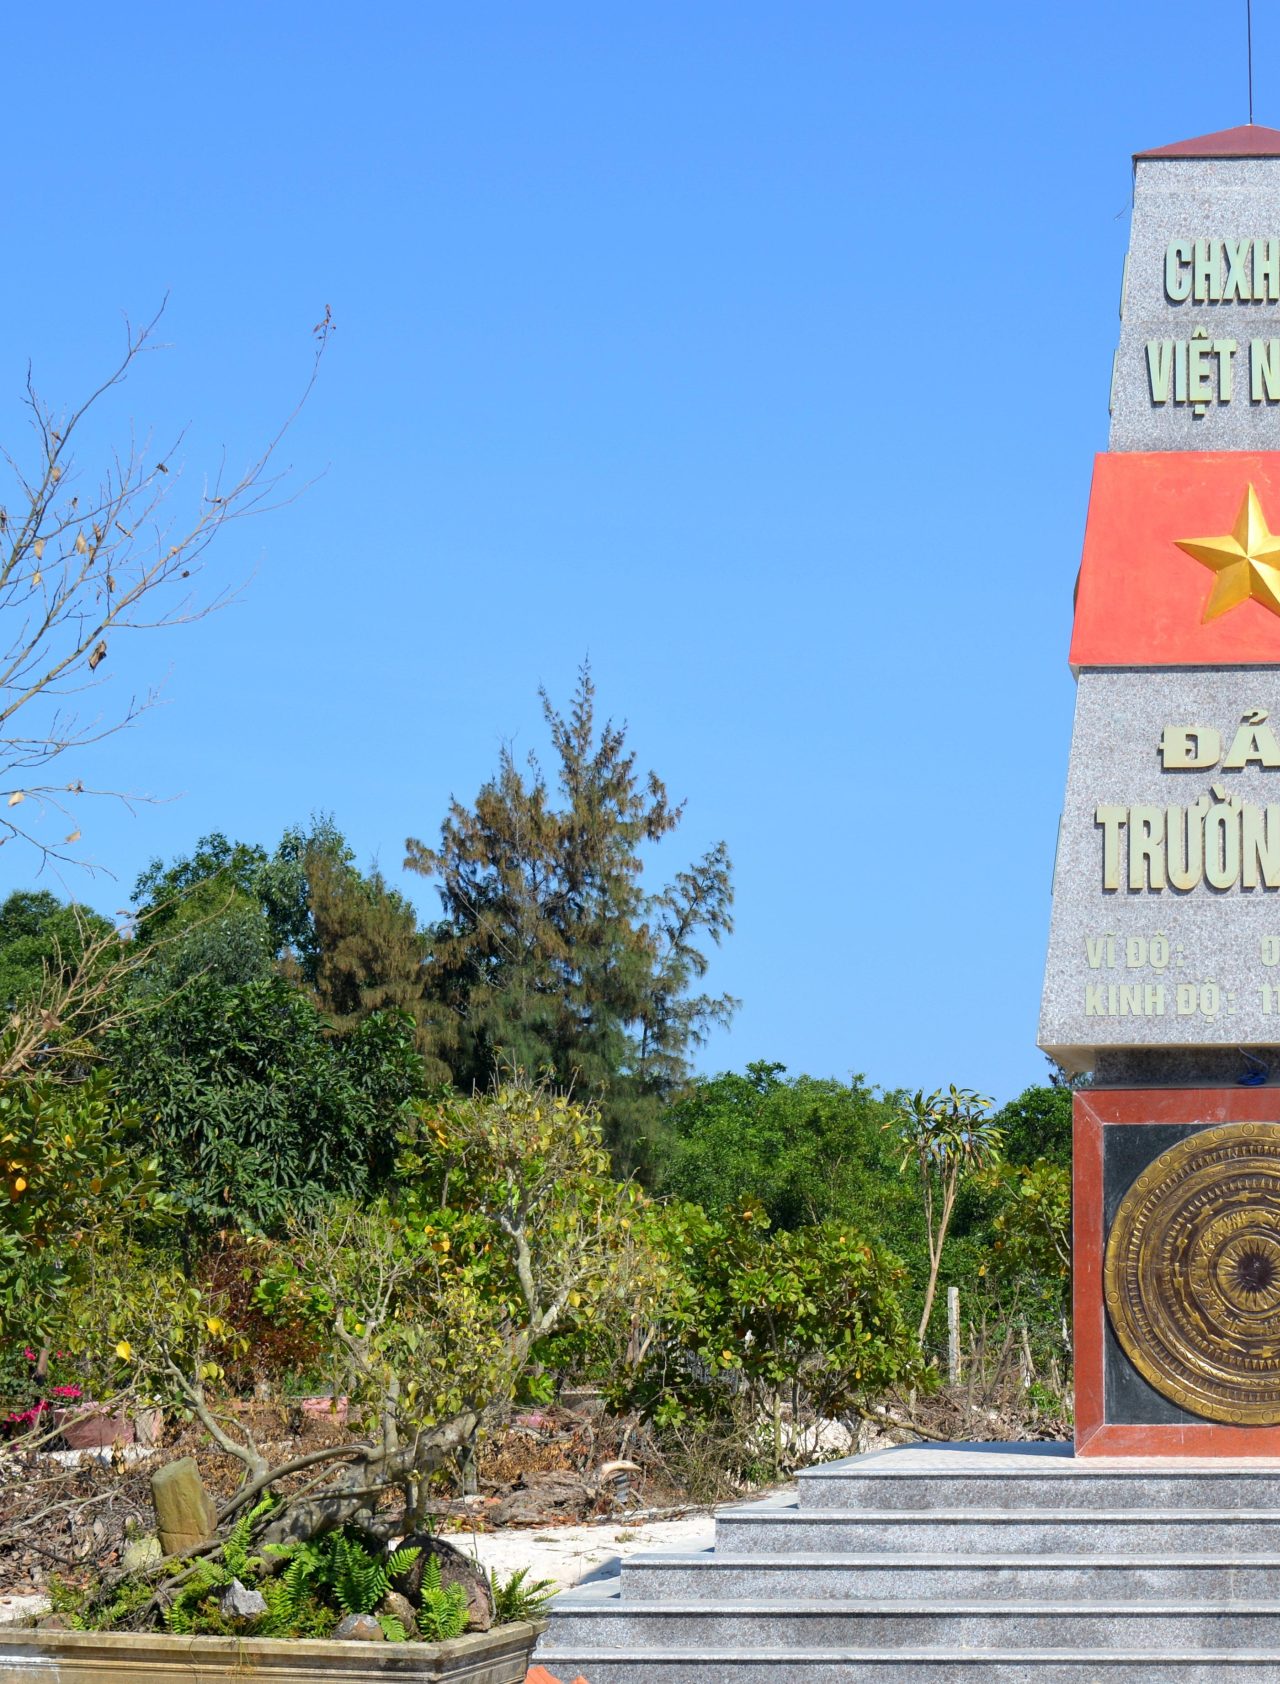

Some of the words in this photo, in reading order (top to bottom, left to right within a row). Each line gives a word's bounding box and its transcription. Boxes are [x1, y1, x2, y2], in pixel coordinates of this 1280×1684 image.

[1146, 324, 1237, 415] VIỆT
[1085, 931, 1117, 968] VĨ
[1085, 983, 1165, 1016] KINH
